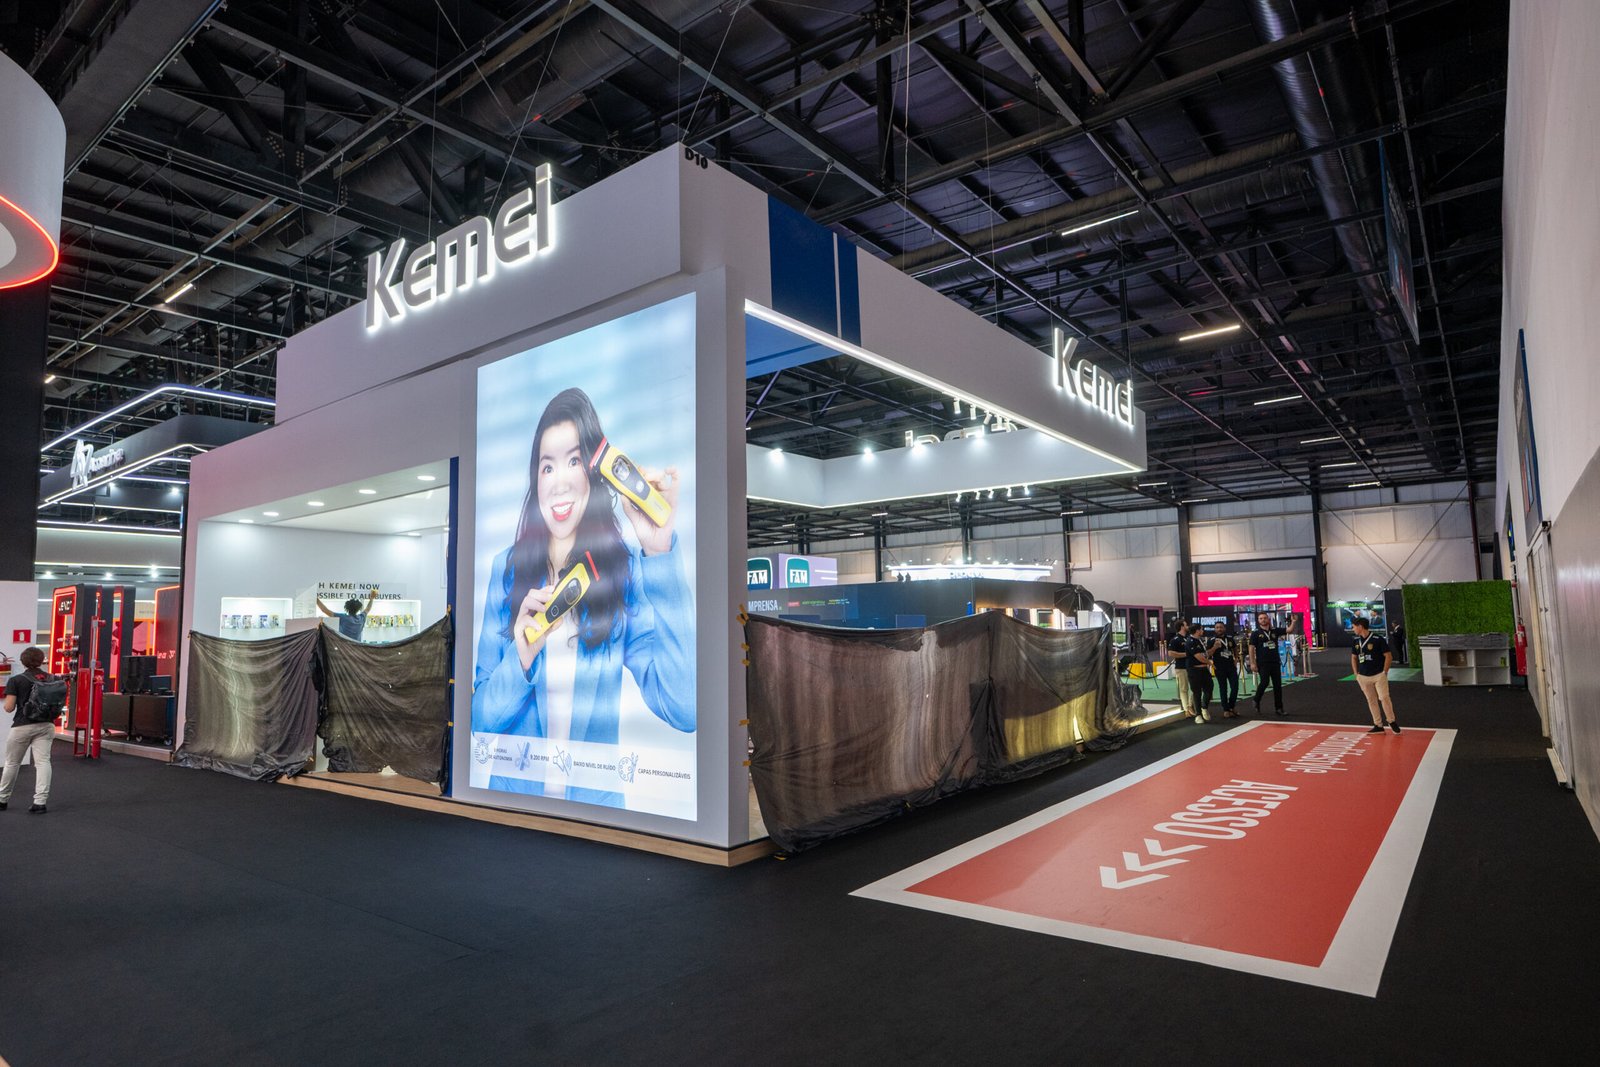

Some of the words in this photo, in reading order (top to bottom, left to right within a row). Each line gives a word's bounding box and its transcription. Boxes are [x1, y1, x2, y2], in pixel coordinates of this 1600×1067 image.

[685, 147, 708, 169] D10
[365, 162, 553, 332] Kemei
[1054, 327, 1135, 428] Kemei
[747, 569, 768, 585] FAM
[790, 568, 808, 584] FAM
[346, 592, 357, 600] TO
[573, 760, 586, 768] BAIXO
[652, 769, 691, 780] PERSONALIZÁVEIS
[1152, 778, 1299, 840] ACESSO
